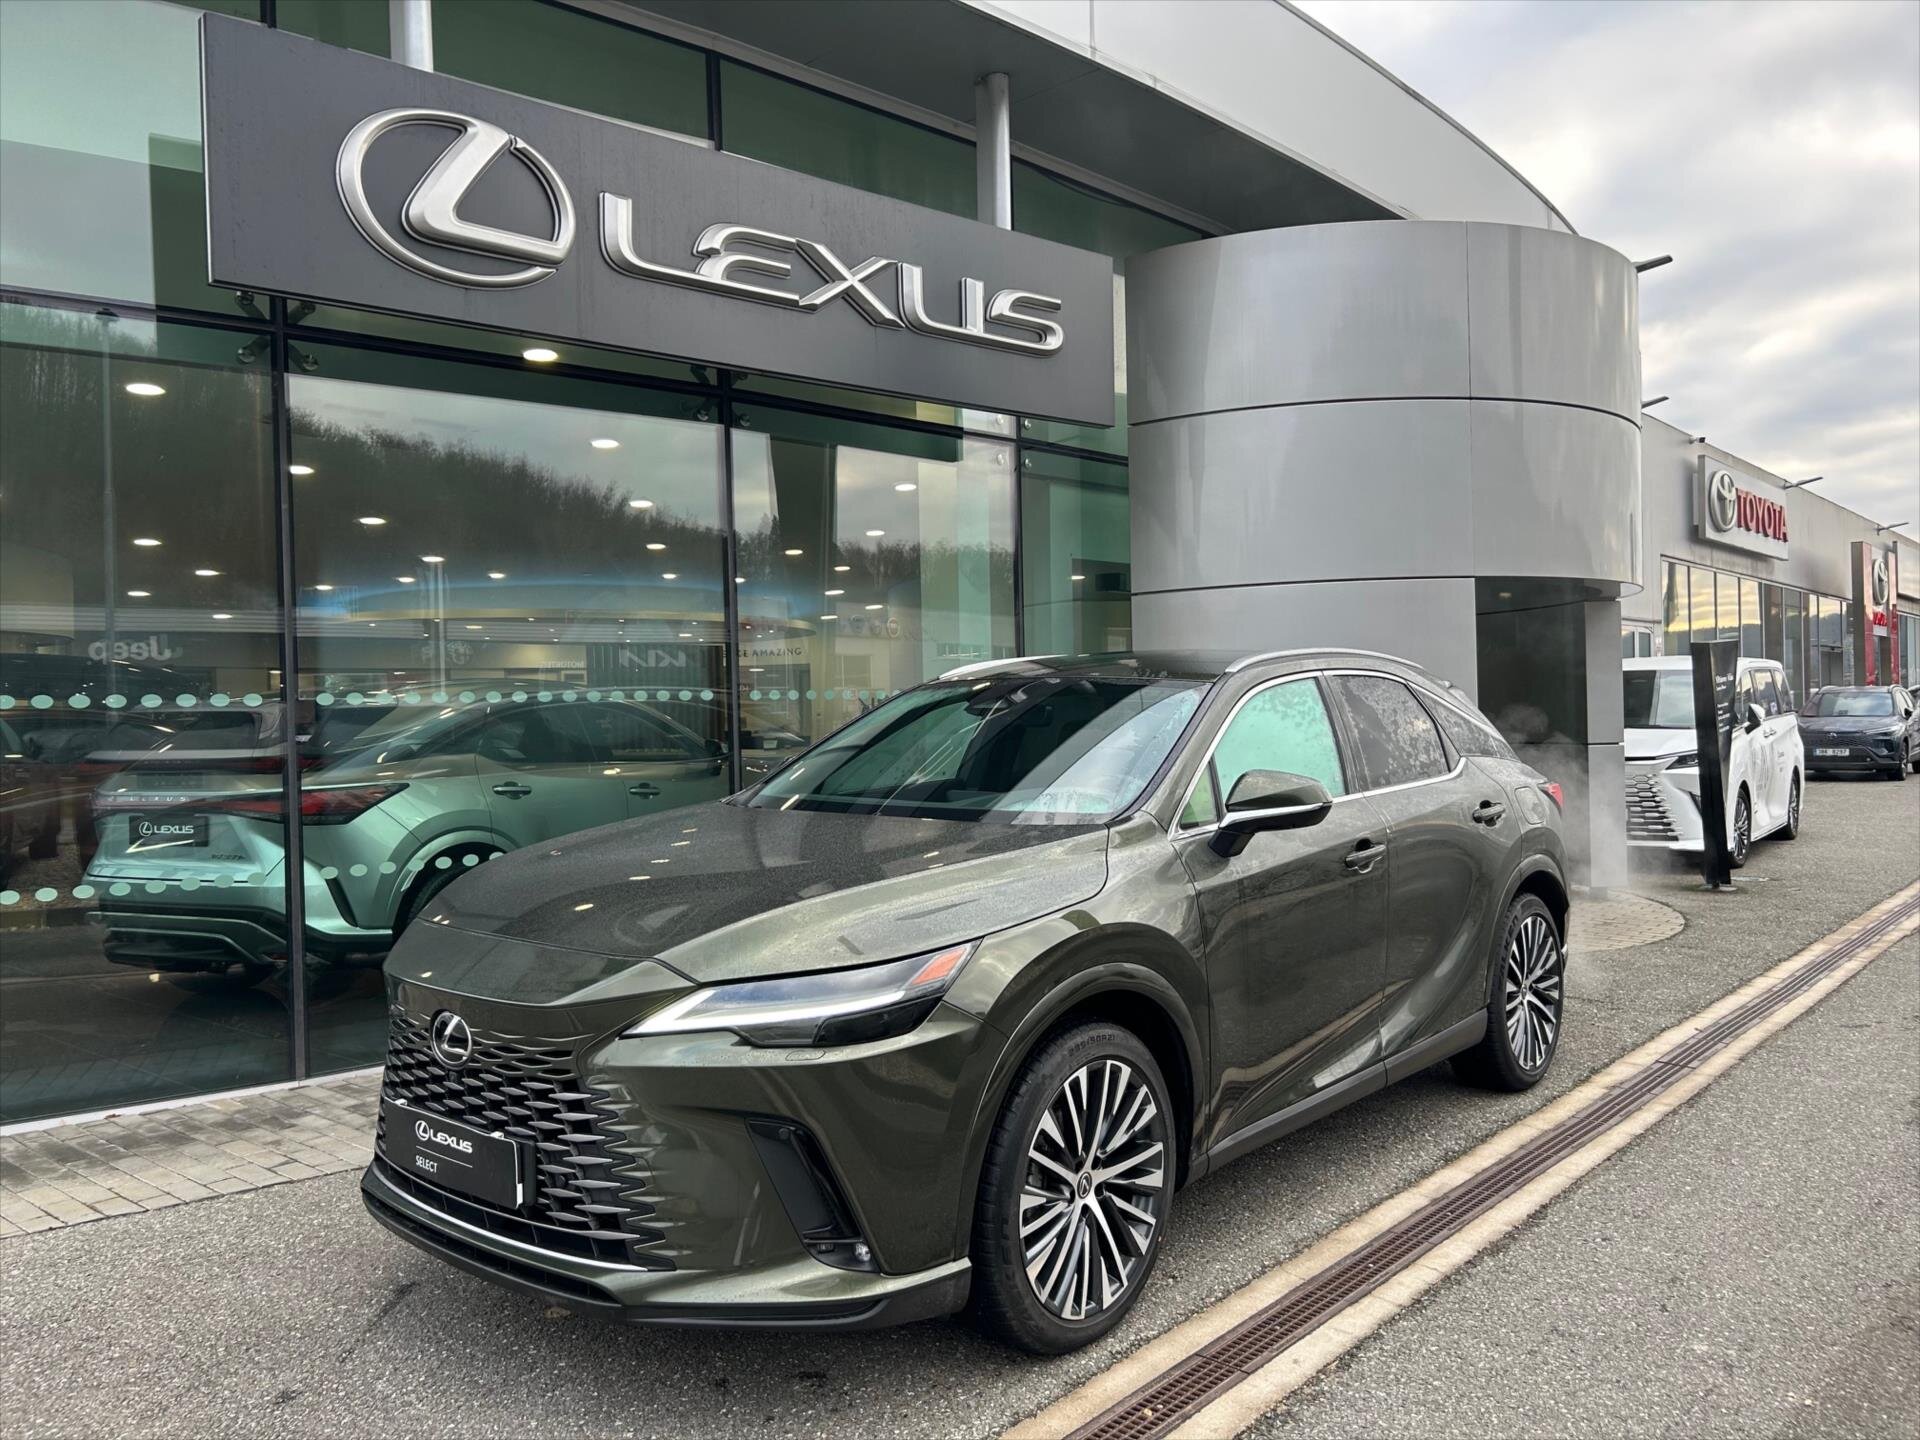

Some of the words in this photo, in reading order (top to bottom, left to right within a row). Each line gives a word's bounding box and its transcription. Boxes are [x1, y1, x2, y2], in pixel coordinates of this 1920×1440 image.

[599, 190, 1065, 358] LEXUS
[1735, 488, 1788, 543] TOYOTA
[751, 647, 802, 657] AMAZING
[153, 825, 194, 834] LEXUS
[430, 1129, 473, 1153] LEXUS
[416, 1155, 437, 1173] SELECT
